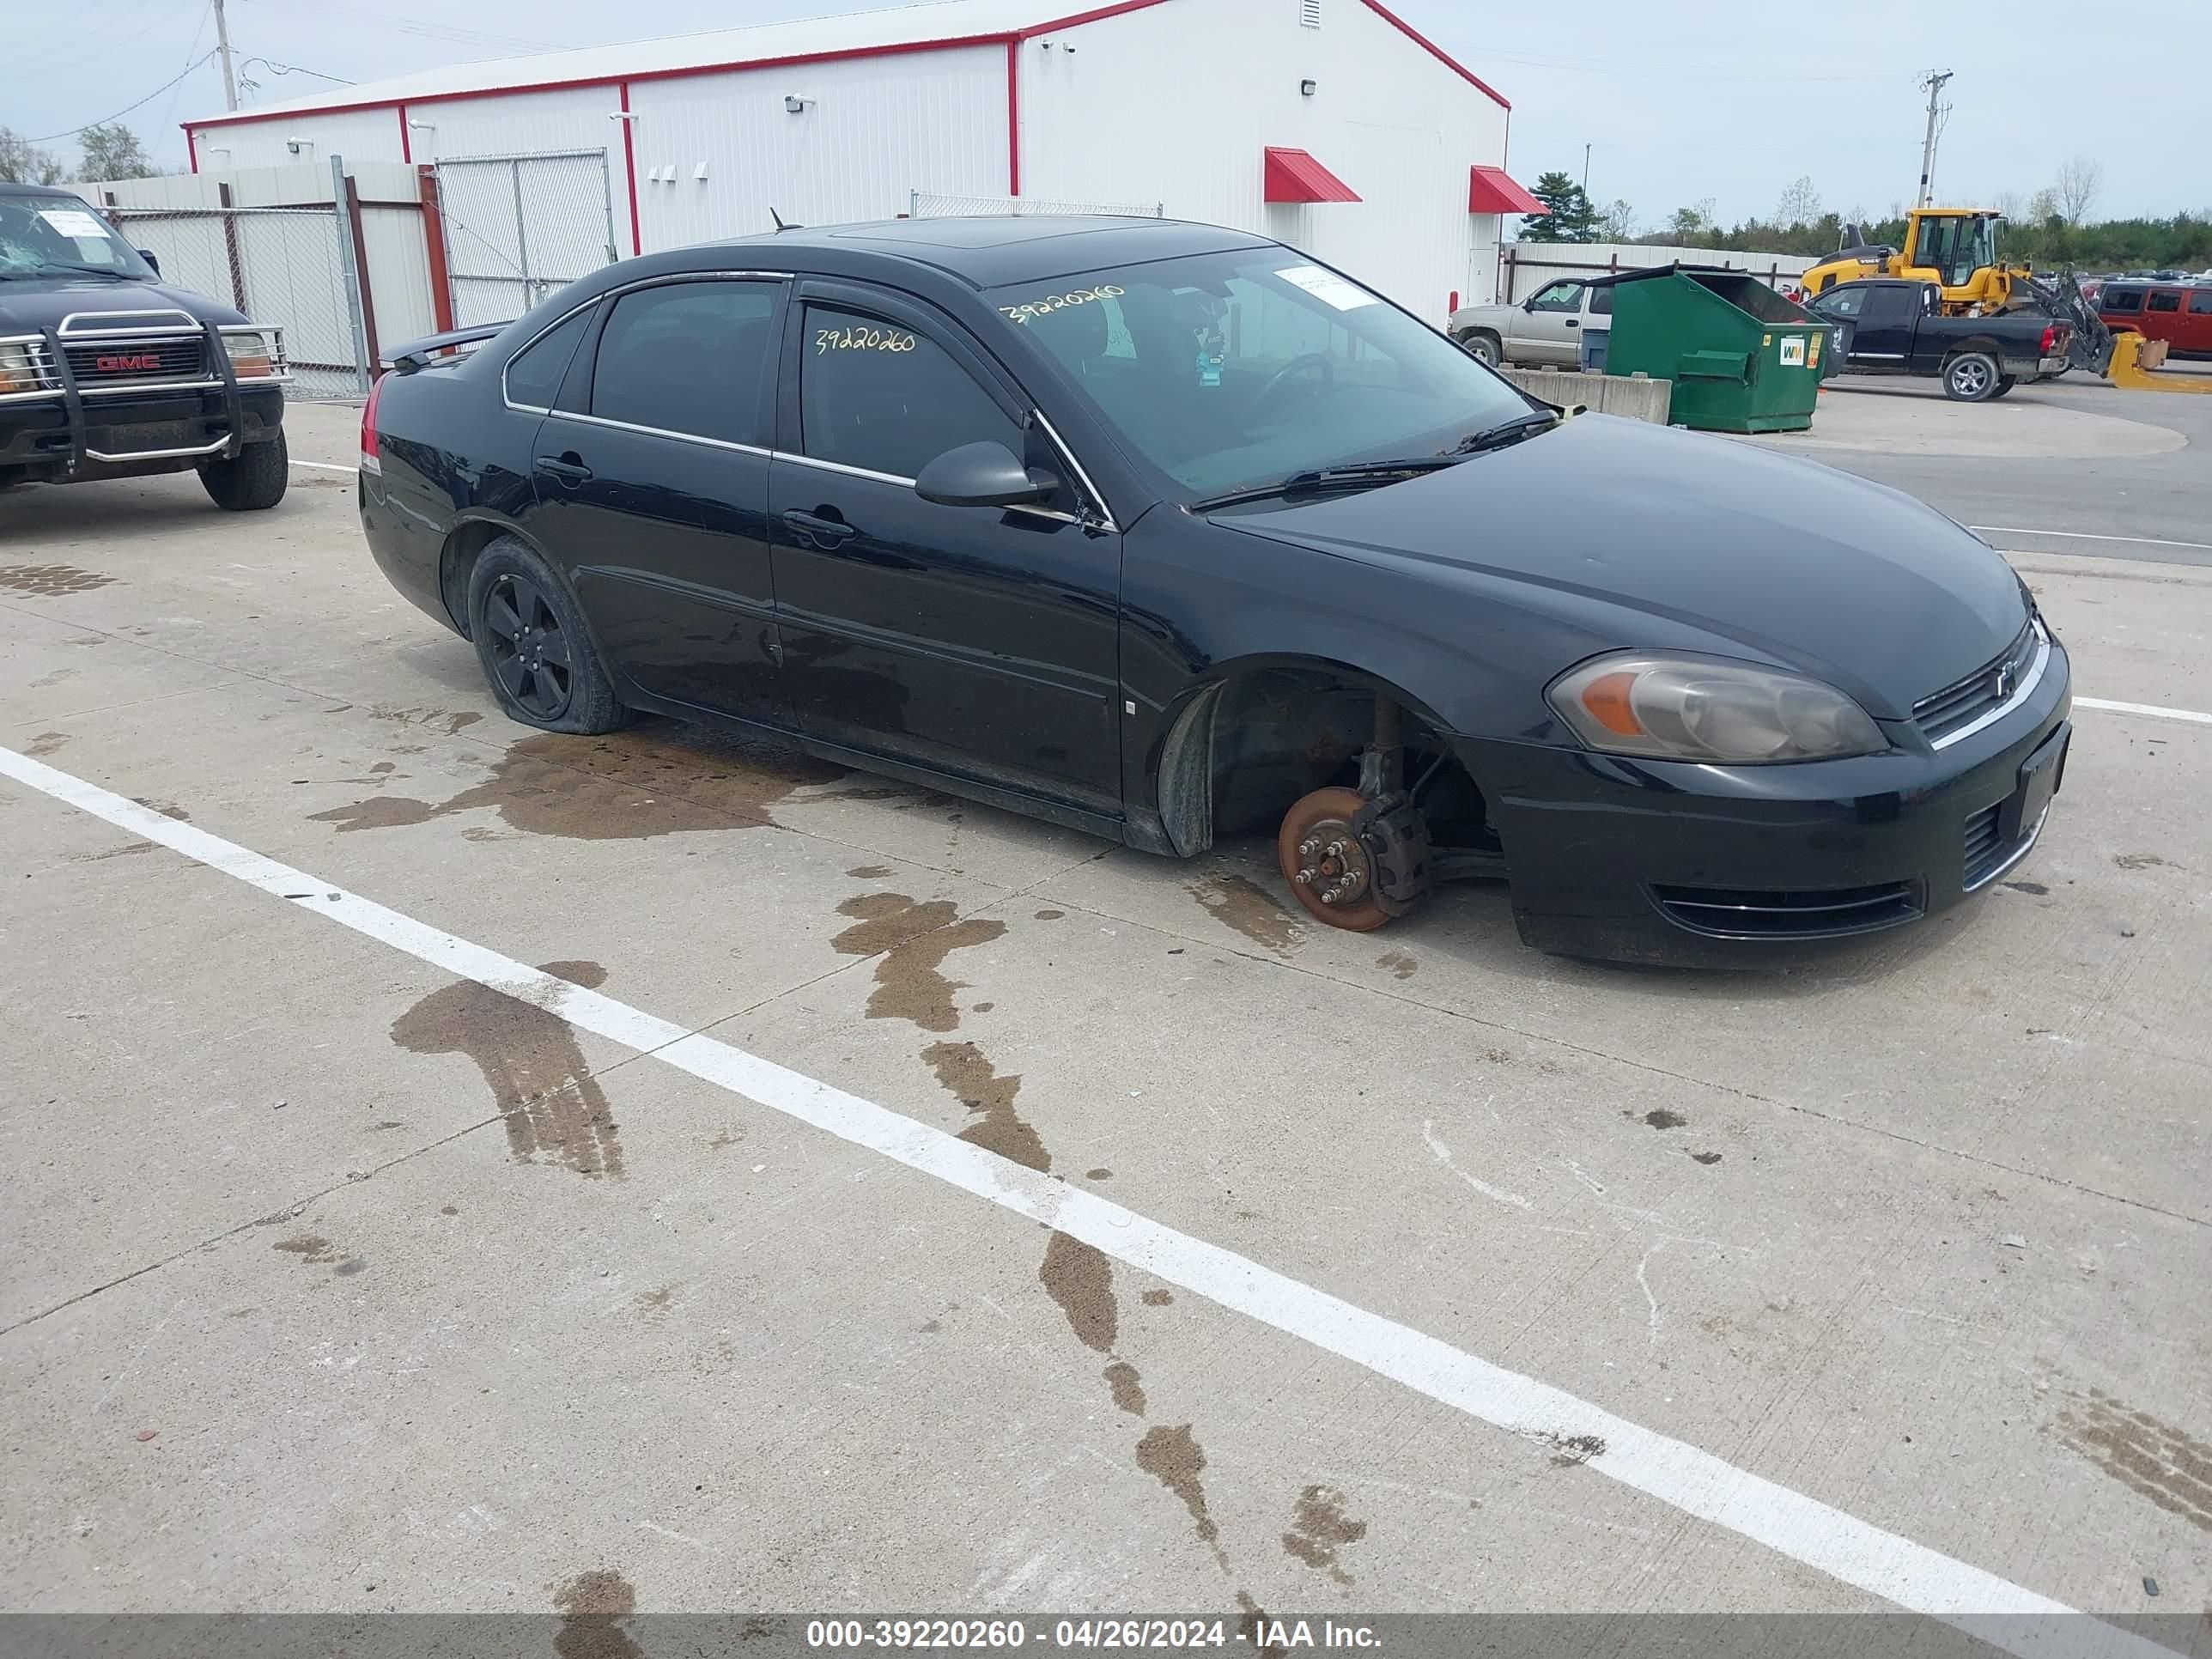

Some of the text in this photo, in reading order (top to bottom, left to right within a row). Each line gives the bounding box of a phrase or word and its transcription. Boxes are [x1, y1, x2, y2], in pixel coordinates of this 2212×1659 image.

[999, 285, 1125, 323] 39220260
[816, 327, 915, 356] 39220260
[1784, 345, 1802, 359] WM
[97, 355, 161, 371] GMC
